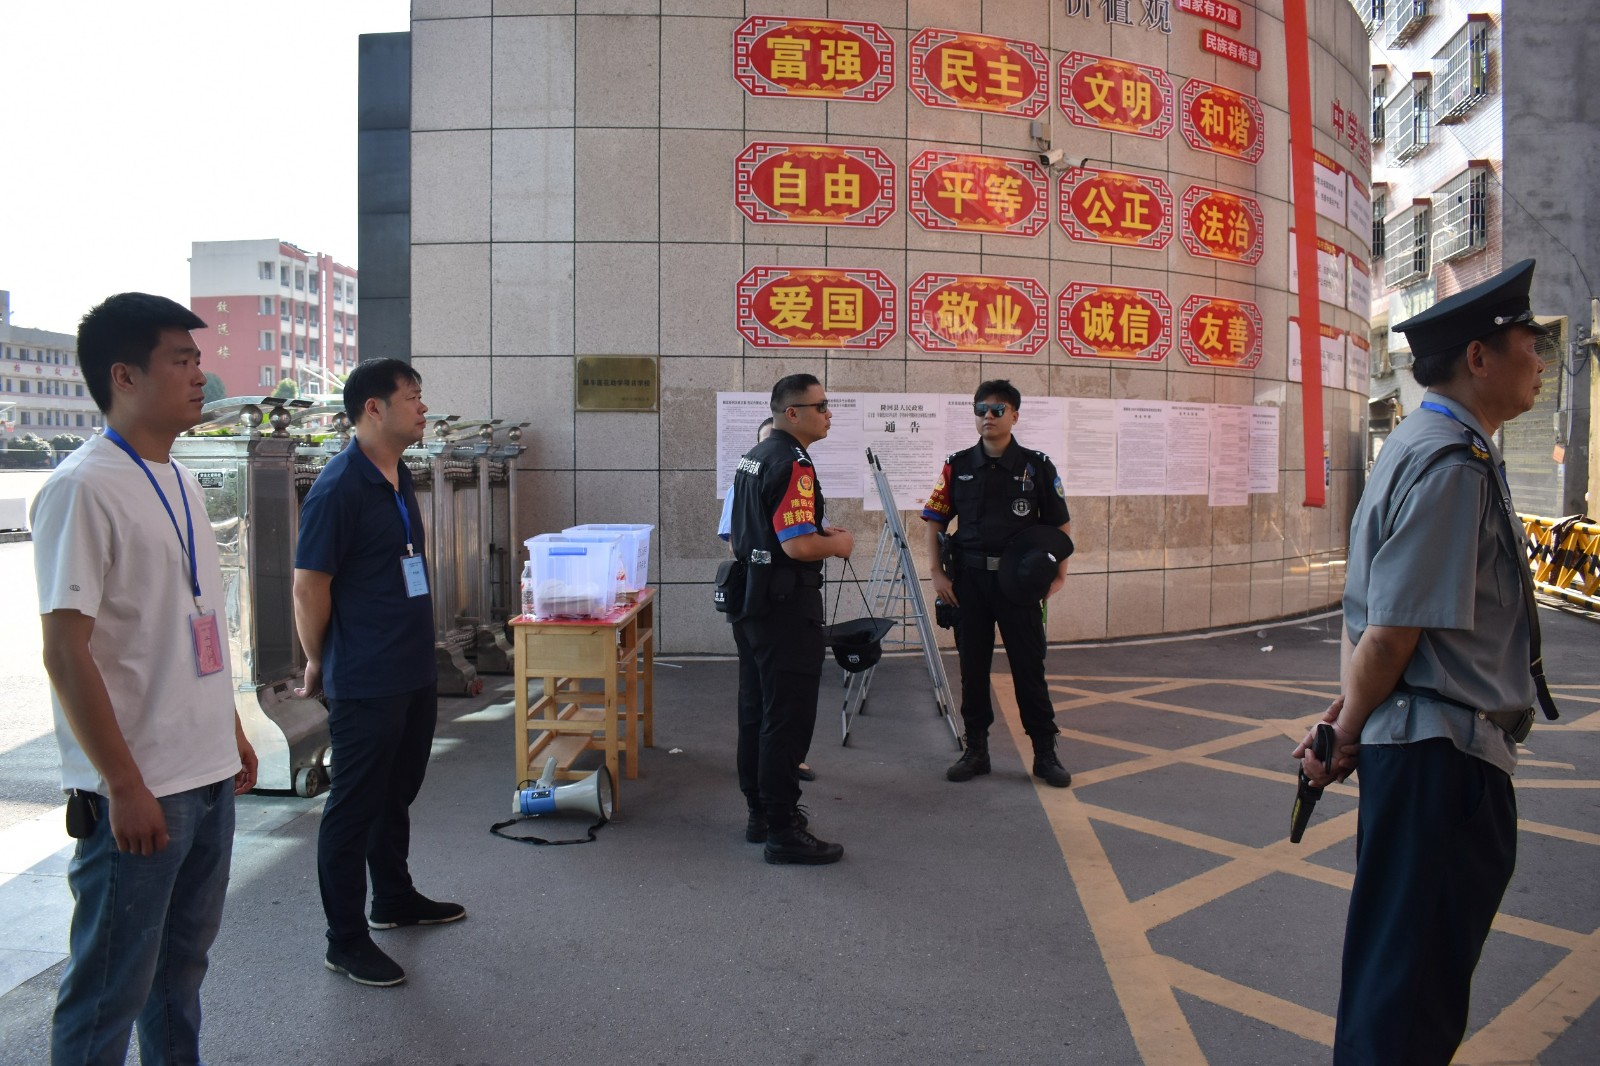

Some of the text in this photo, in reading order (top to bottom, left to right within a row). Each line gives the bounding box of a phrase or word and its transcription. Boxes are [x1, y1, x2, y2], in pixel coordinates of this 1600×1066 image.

[766, 37, 863, 83] 富强
[1205, 33, 1259, 66] 民族有希望
[940, 48, 1023, 98] 民主
[1084, 73, 1151, 120] 文明
[1200, 97, 1250, 147] 和谐
[772, 162, 860, 208] 自由
[938, 167, 1023, 218] 平等
[1082, 184, 1152, 231] 公正
[1199, 203, 1249, 250] 法治
[769, 286, 863, 331] 爱国
[937, 291, 1022, 338] 敬业
[1081, 302, 1151, 346] 诚信
[1199, 313, 1249, 354] 友善
[884, 421, 920, 433] 通告
